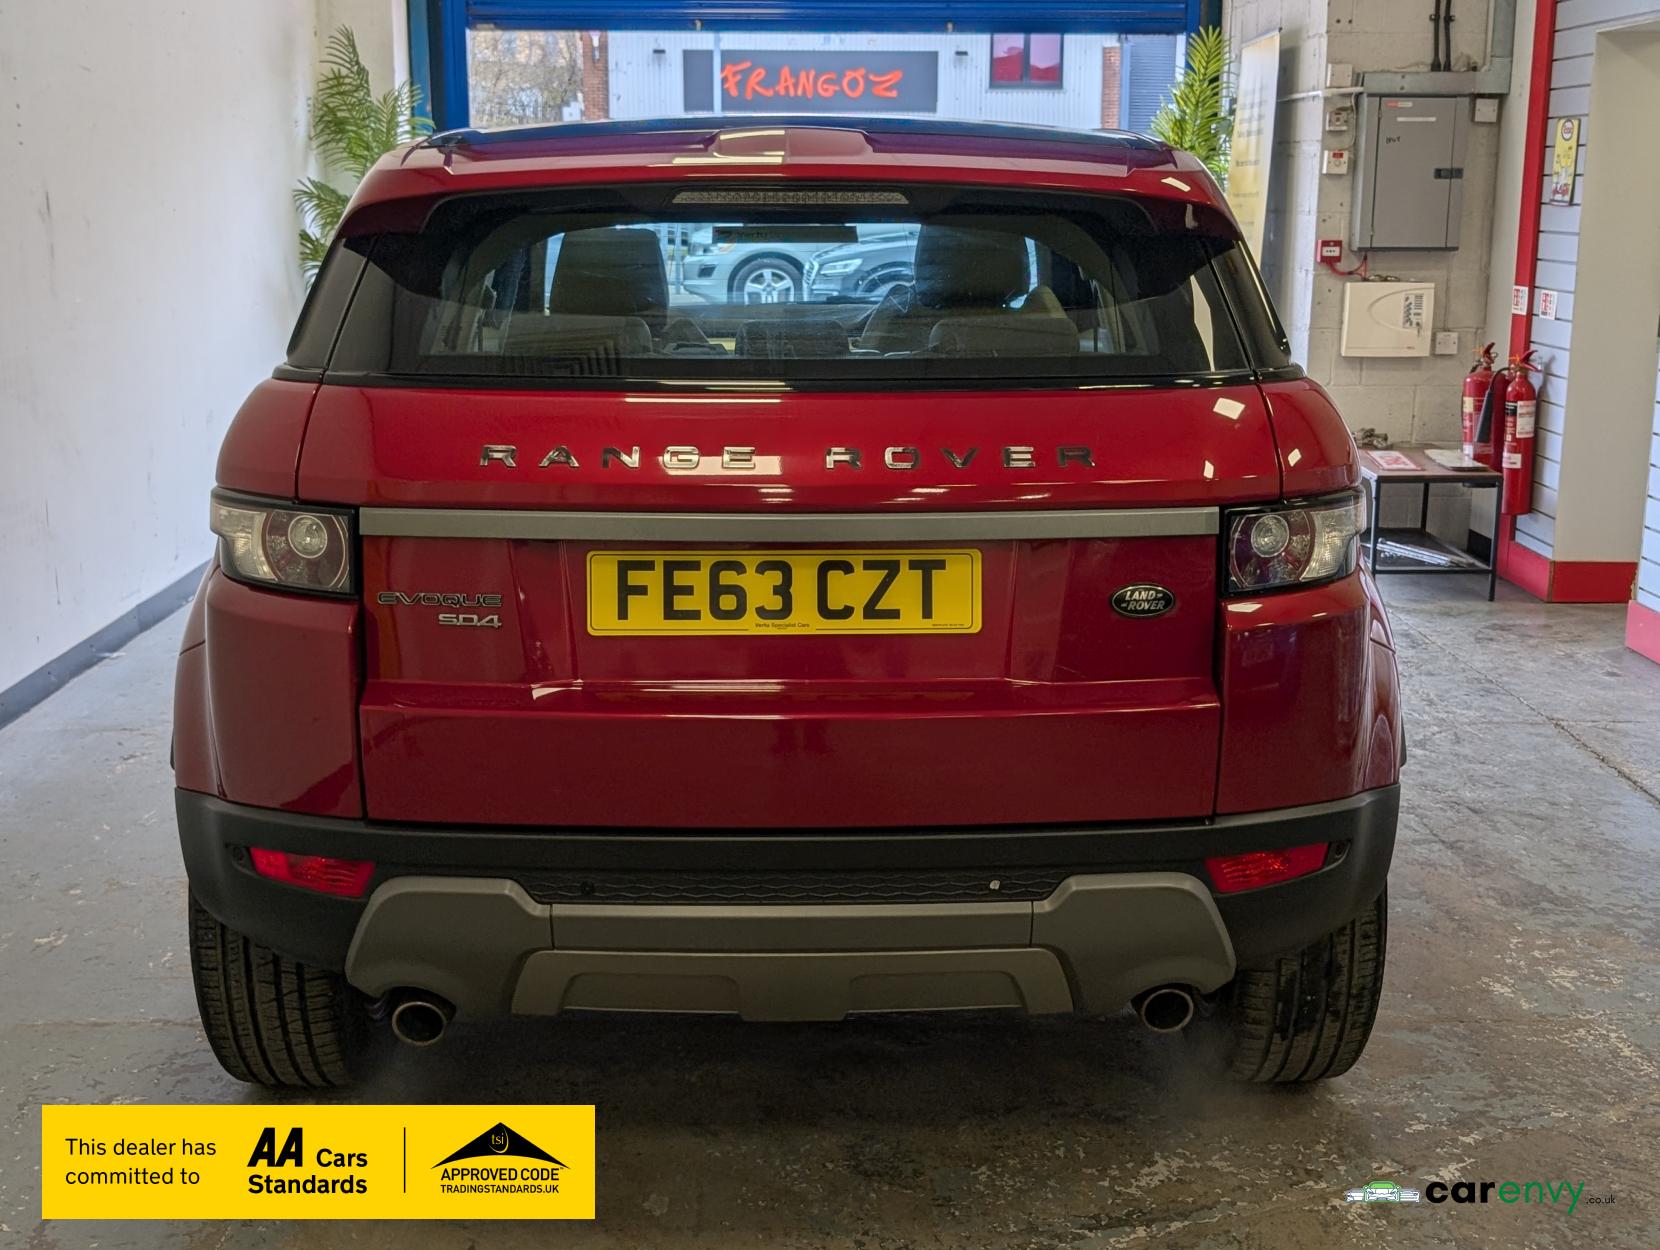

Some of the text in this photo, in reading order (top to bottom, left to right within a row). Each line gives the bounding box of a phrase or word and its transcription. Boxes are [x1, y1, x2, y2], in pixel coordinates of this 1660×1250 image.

[479, 445, 1096, 470] RANGE ROVER
[377, 591, 502, 608] EVOQUE
[617, 559, 947, 621] FE63 CZT
[438, 613, 502, 629] SD4
